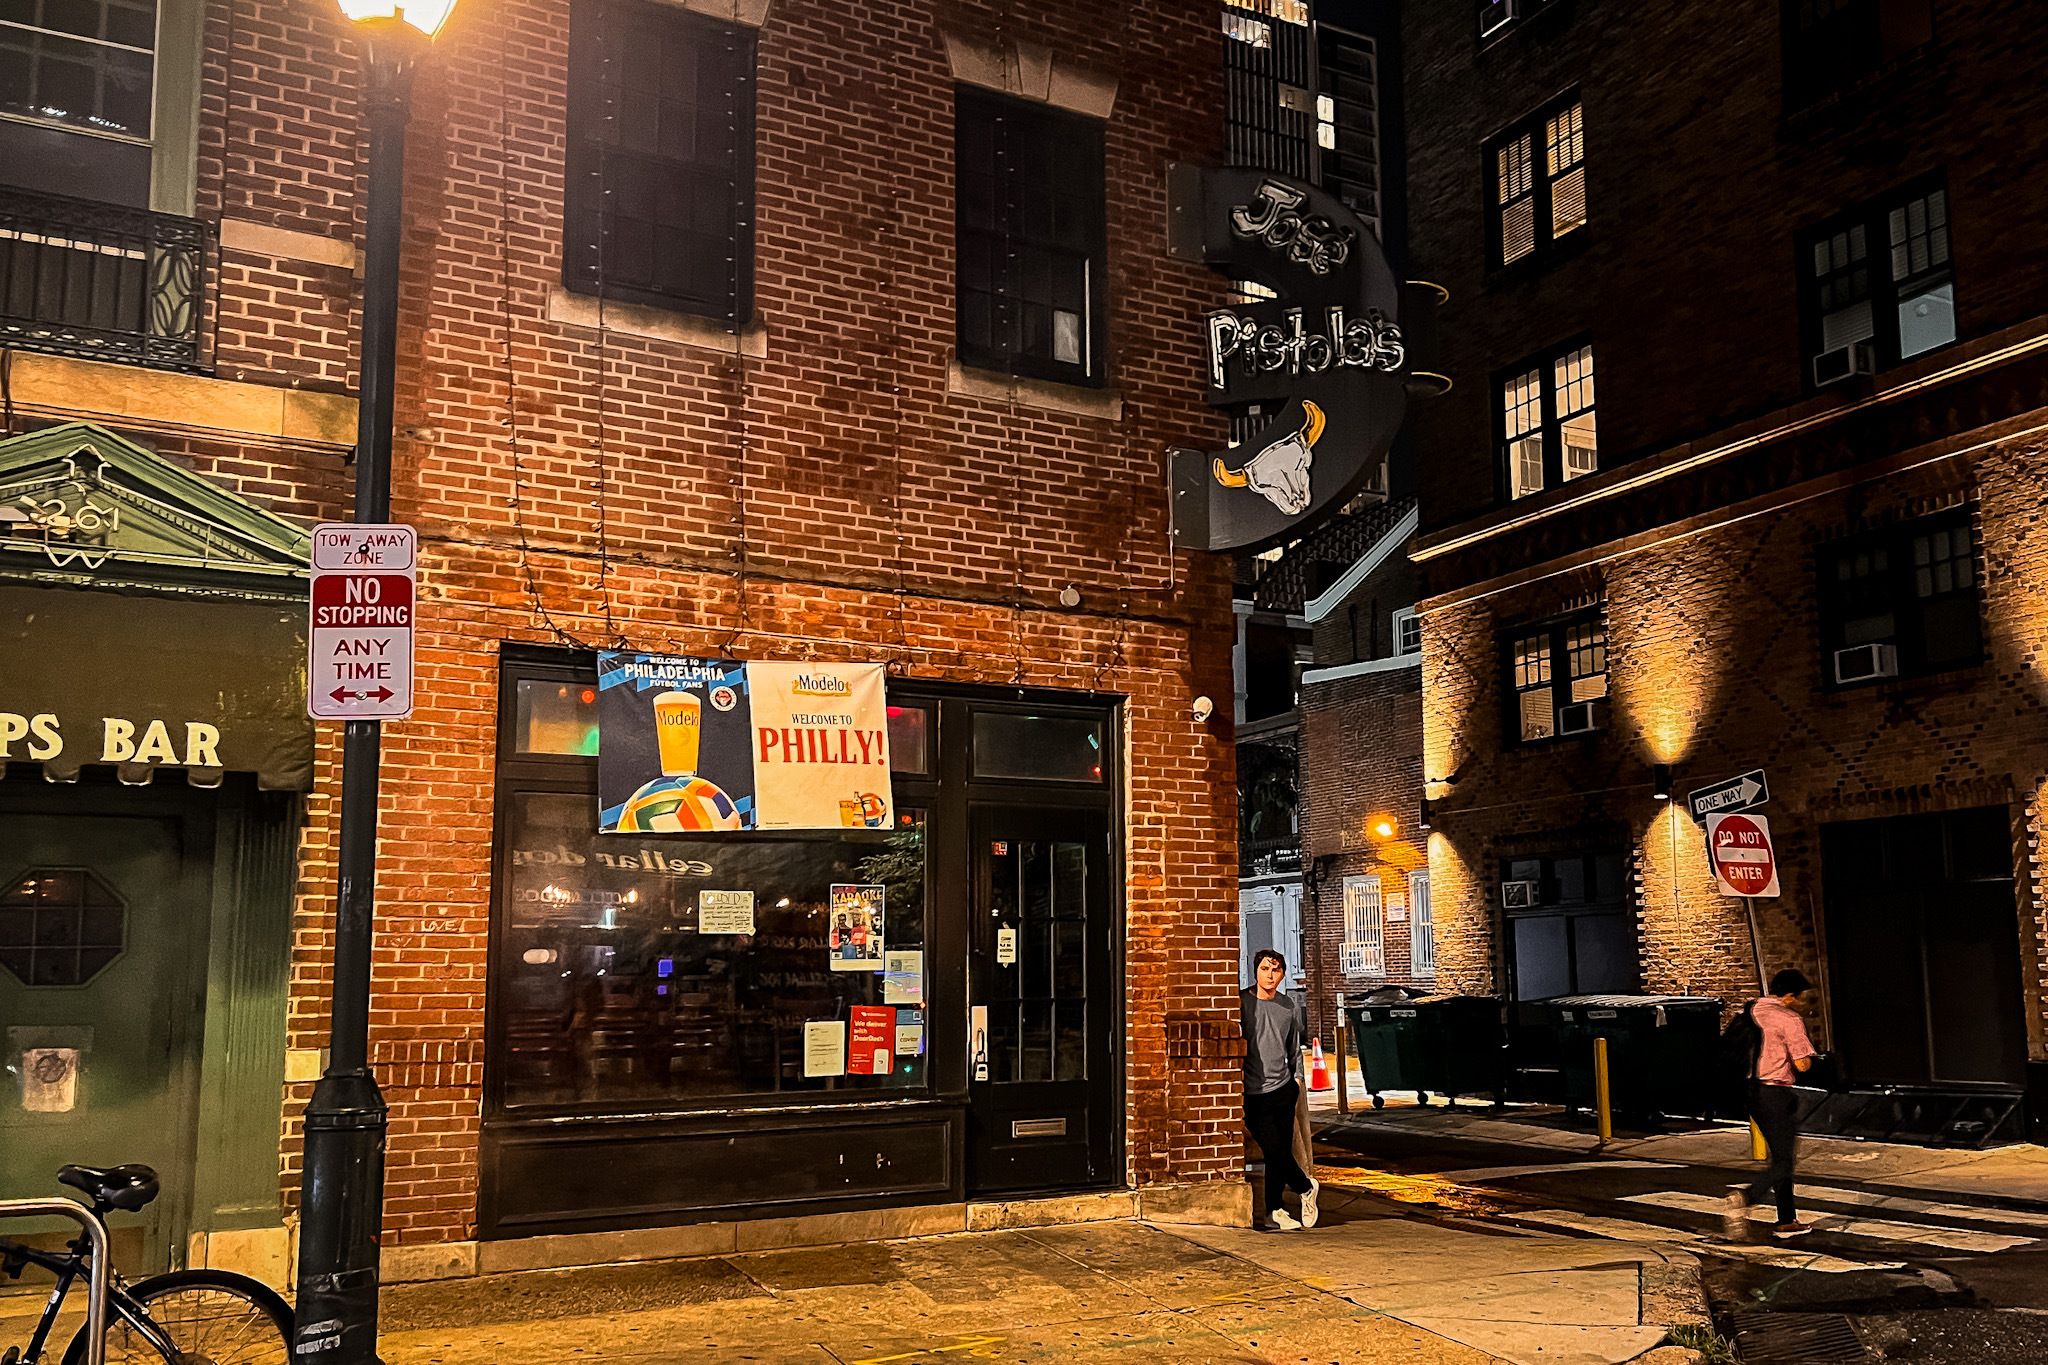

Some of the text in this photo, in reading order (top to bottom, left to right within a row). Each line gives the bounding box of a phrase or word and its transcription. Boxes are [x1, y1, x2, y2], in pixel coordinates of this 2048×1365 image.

[1206, 305, 1405, 391] Pistola's
[319, 534, 351, 547] TOW
[365, 534, 408, 547] AWAY
[343, 551, 384, 565] ZONE
[345, 577, 381, 604] NO
[317, 606, 408, 625] STOPPING
[333, 638, 392, 656] ANY
[648, 656, 700, 667] WELCOME TO
[332, 662, 392, 680] TIME
[624, 663, 726, 681] PHILADELPHIA
[682, 680, 703, 689] FANS
[798, 674, 845, 692] Modelo
[657, 710, 699, 726] Modelo
[791, 713, 853, 726] WELCOME TO
[100, 717, 224, 767] BAR
[758, 727, 885, 766] PHILLY!
[1698, 786, 1742, 811] ONE WAY
[1718, 830, 1760, 844] DO NOT
[1728, 866, 1764, 880] ENTER
[832, 889, 883, 904] KARAOKE
